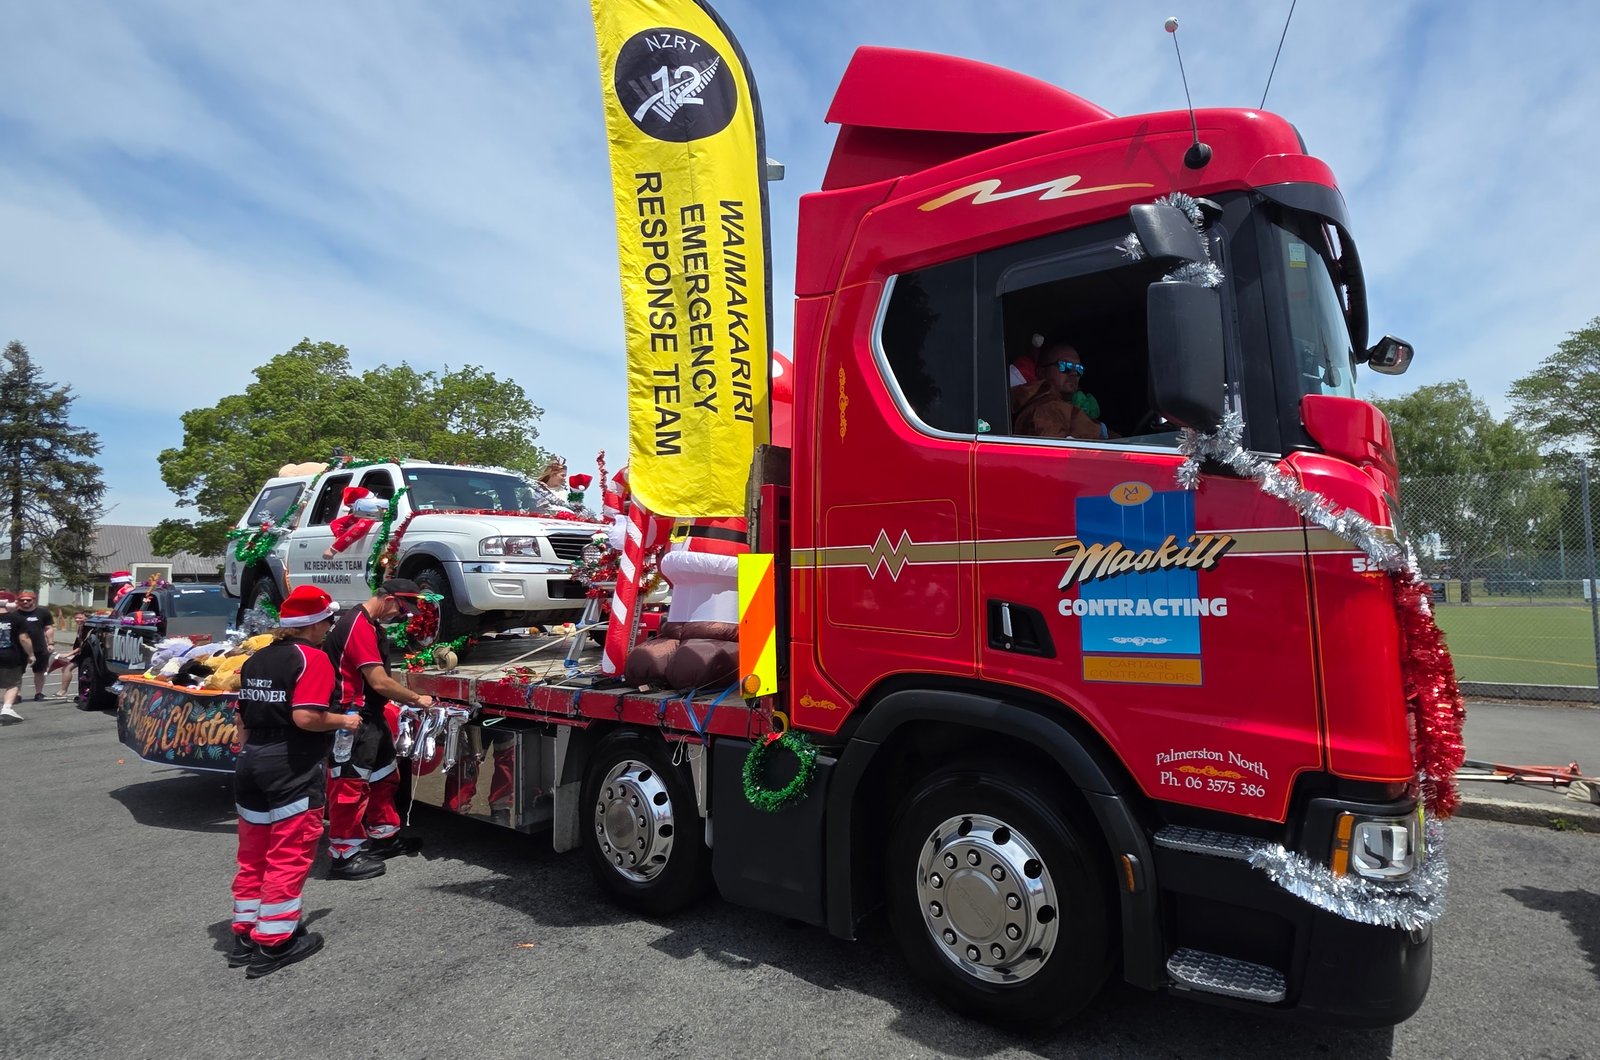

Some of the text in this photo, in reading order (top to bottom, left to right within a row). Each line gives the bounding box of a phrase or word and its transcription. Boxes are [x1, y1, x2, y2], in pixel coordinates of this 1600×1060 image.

[645, 34, 701, 54] NZRT
[651, 65, 704, 106] 12
[634, 171, 682, 457] RESPONSE TEAM
[680, 203, 719, 414] EMERGENCY
[719, 199, 754, 424] WAIMAKARIRI
[304, 560, 362, 571] NZ RESPONSE TEAM
[1053, 534, 1235, 591] Maskill
[312, 575, 351, 584] WAIMAKARIRI
[1058, 598, 1228, 617] CONTRACTING
[1089, 670, 1195, 682] CONTRACTORS
[1108, 659, 1173, 671] CARTAGE
[161, 702, 239, 751] Christm
[1156, 748, 1269, 779] Palmerston North
[1160, 771, 1266, 798] Ph. 06 3575 386
